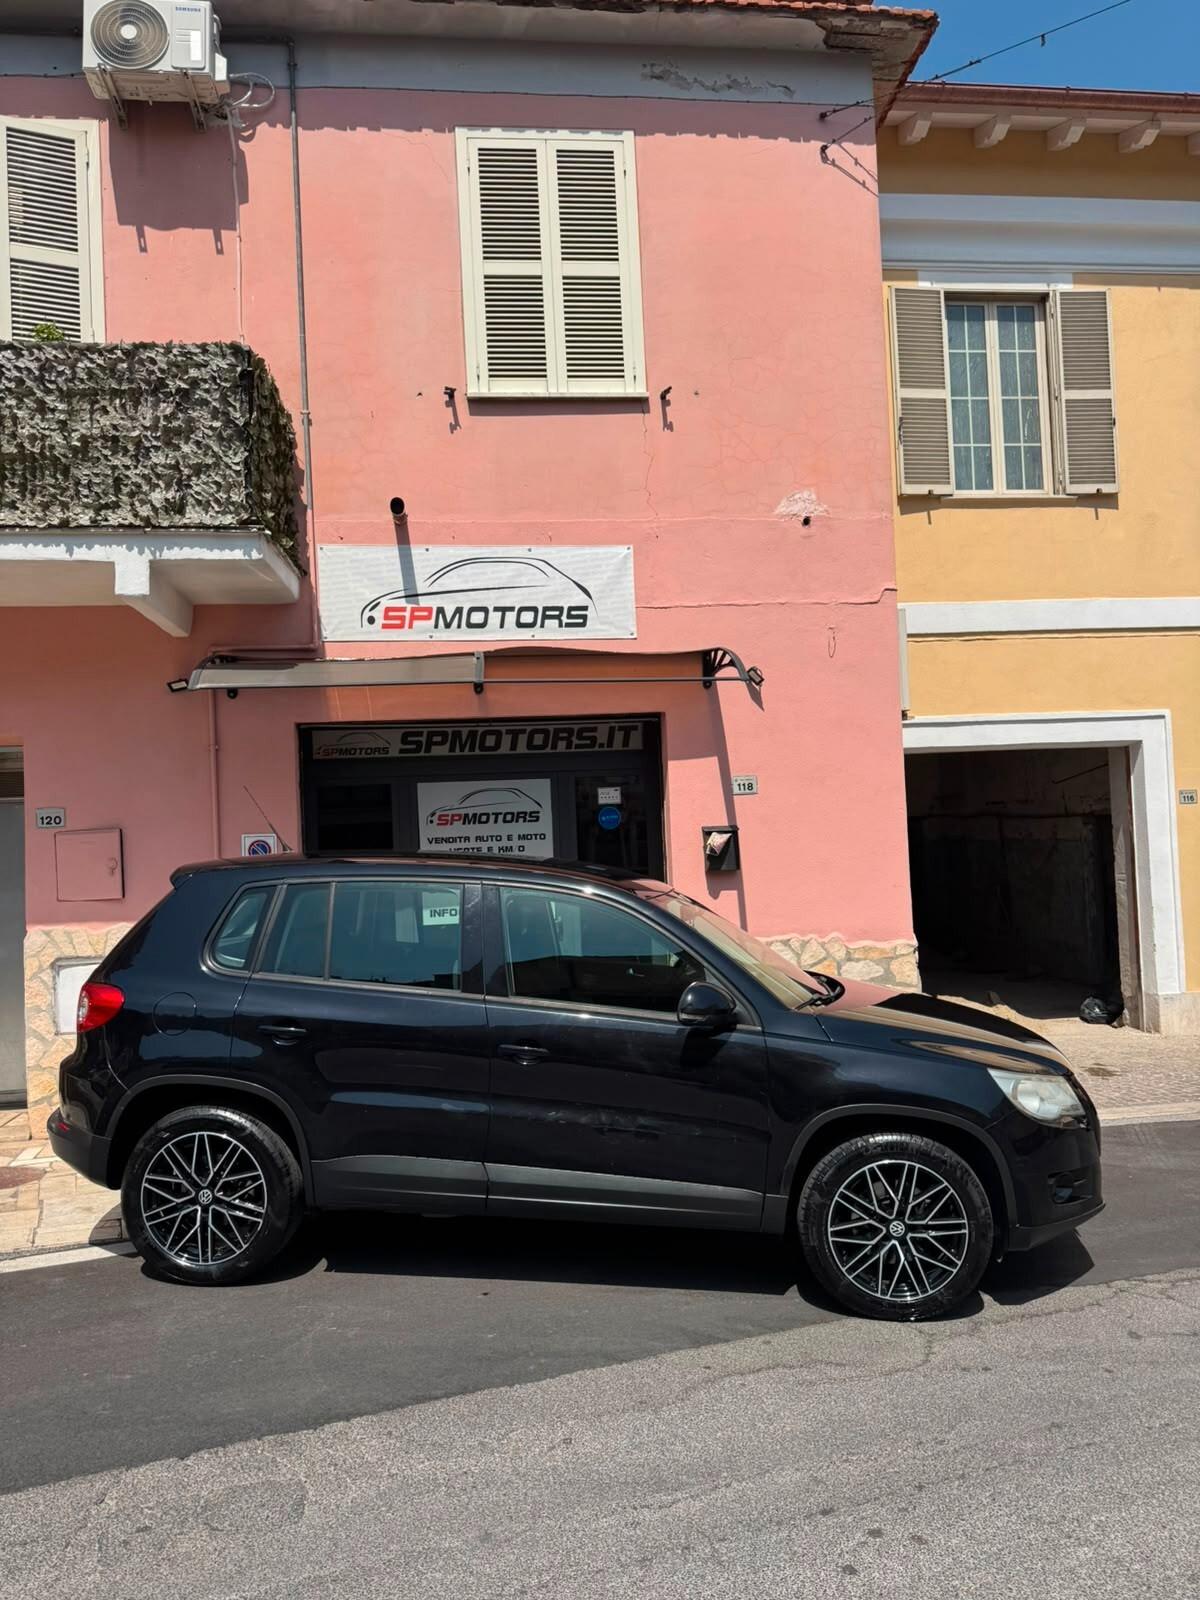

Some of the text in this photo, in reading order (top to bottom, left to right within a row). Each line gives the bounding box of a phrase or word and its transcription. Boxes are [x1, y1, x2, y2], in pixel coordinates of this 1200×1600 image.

[381, 605, 589, 629] SPMOTORS
[321, 724, 639, 757] SPMOTORS SPMOTORS.IT
[737, 782, 754, 791] 118
[39, 815, 62, 825] 120
[436, 810, 541, 826] SPMOTORS
[427, 833, 547, 845] VENDITA AUTO E MOTO
[498, 845, 514, 854] KM
[430, 908, 458, 918] INFO
